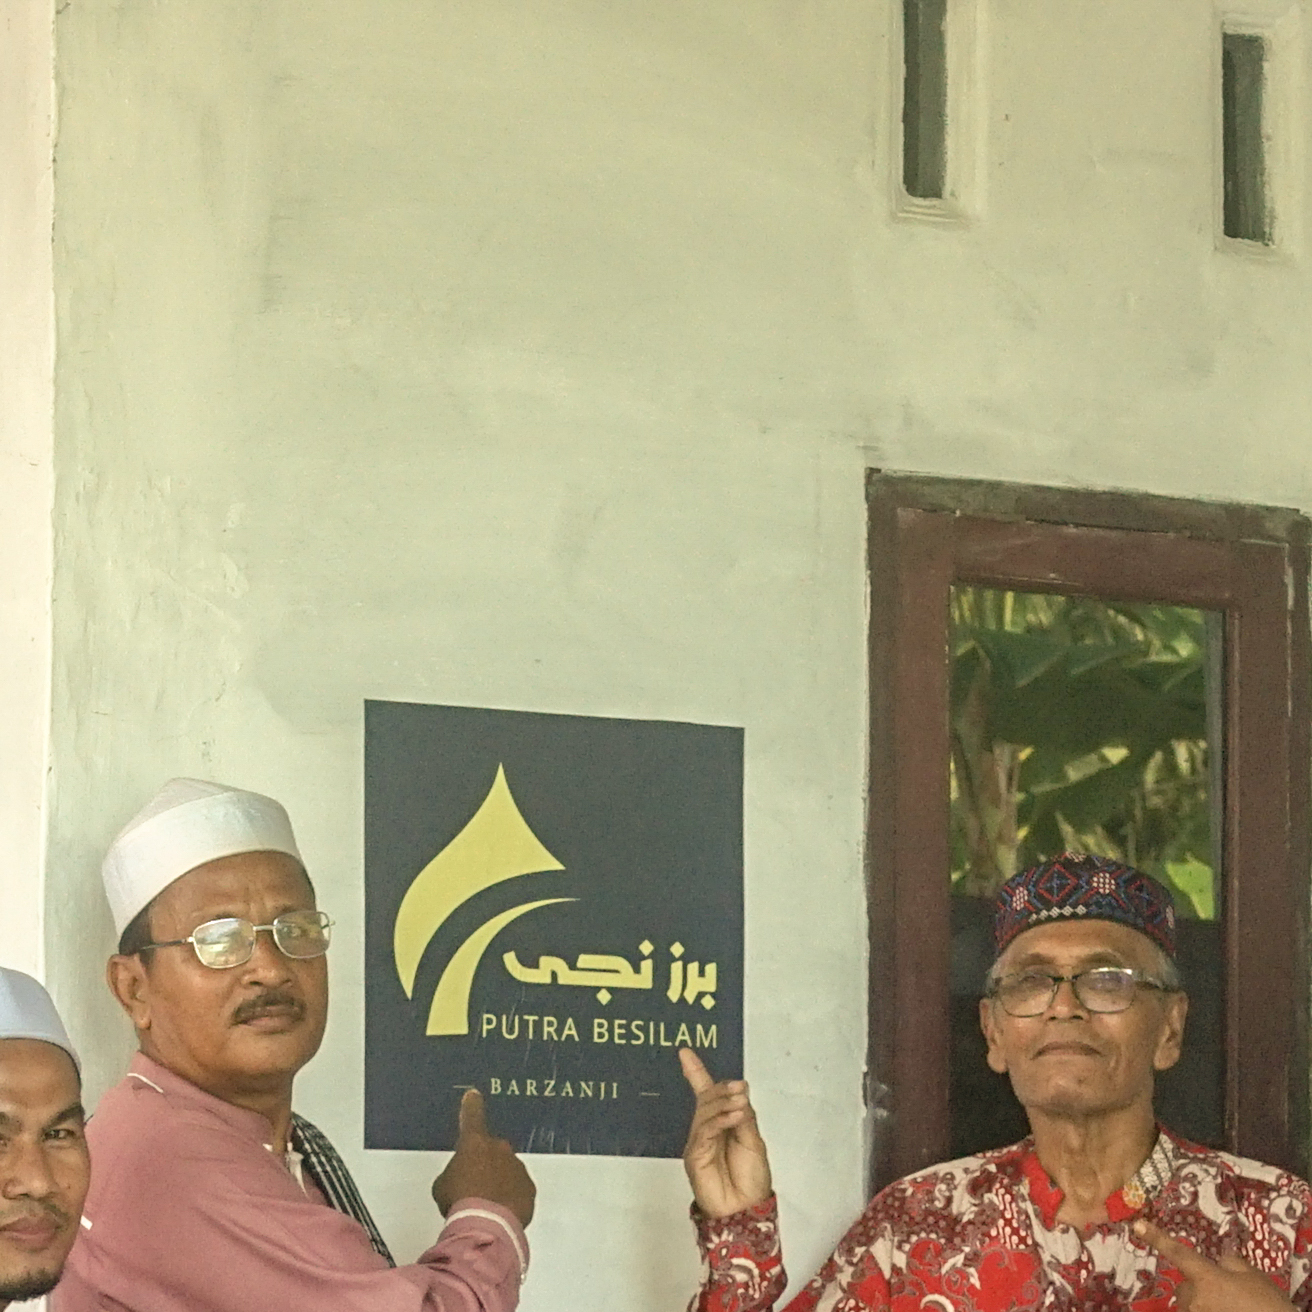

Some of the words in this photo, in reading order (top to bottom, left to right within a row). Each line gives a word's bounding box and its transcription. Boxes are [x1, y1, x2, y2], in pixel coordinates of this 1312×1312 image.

[481, 1013, 580, 1042] PUTRA
[592, 1018, 718, 1049] BESILAM
[490, 1077, 619, 1101] BARZANJI
